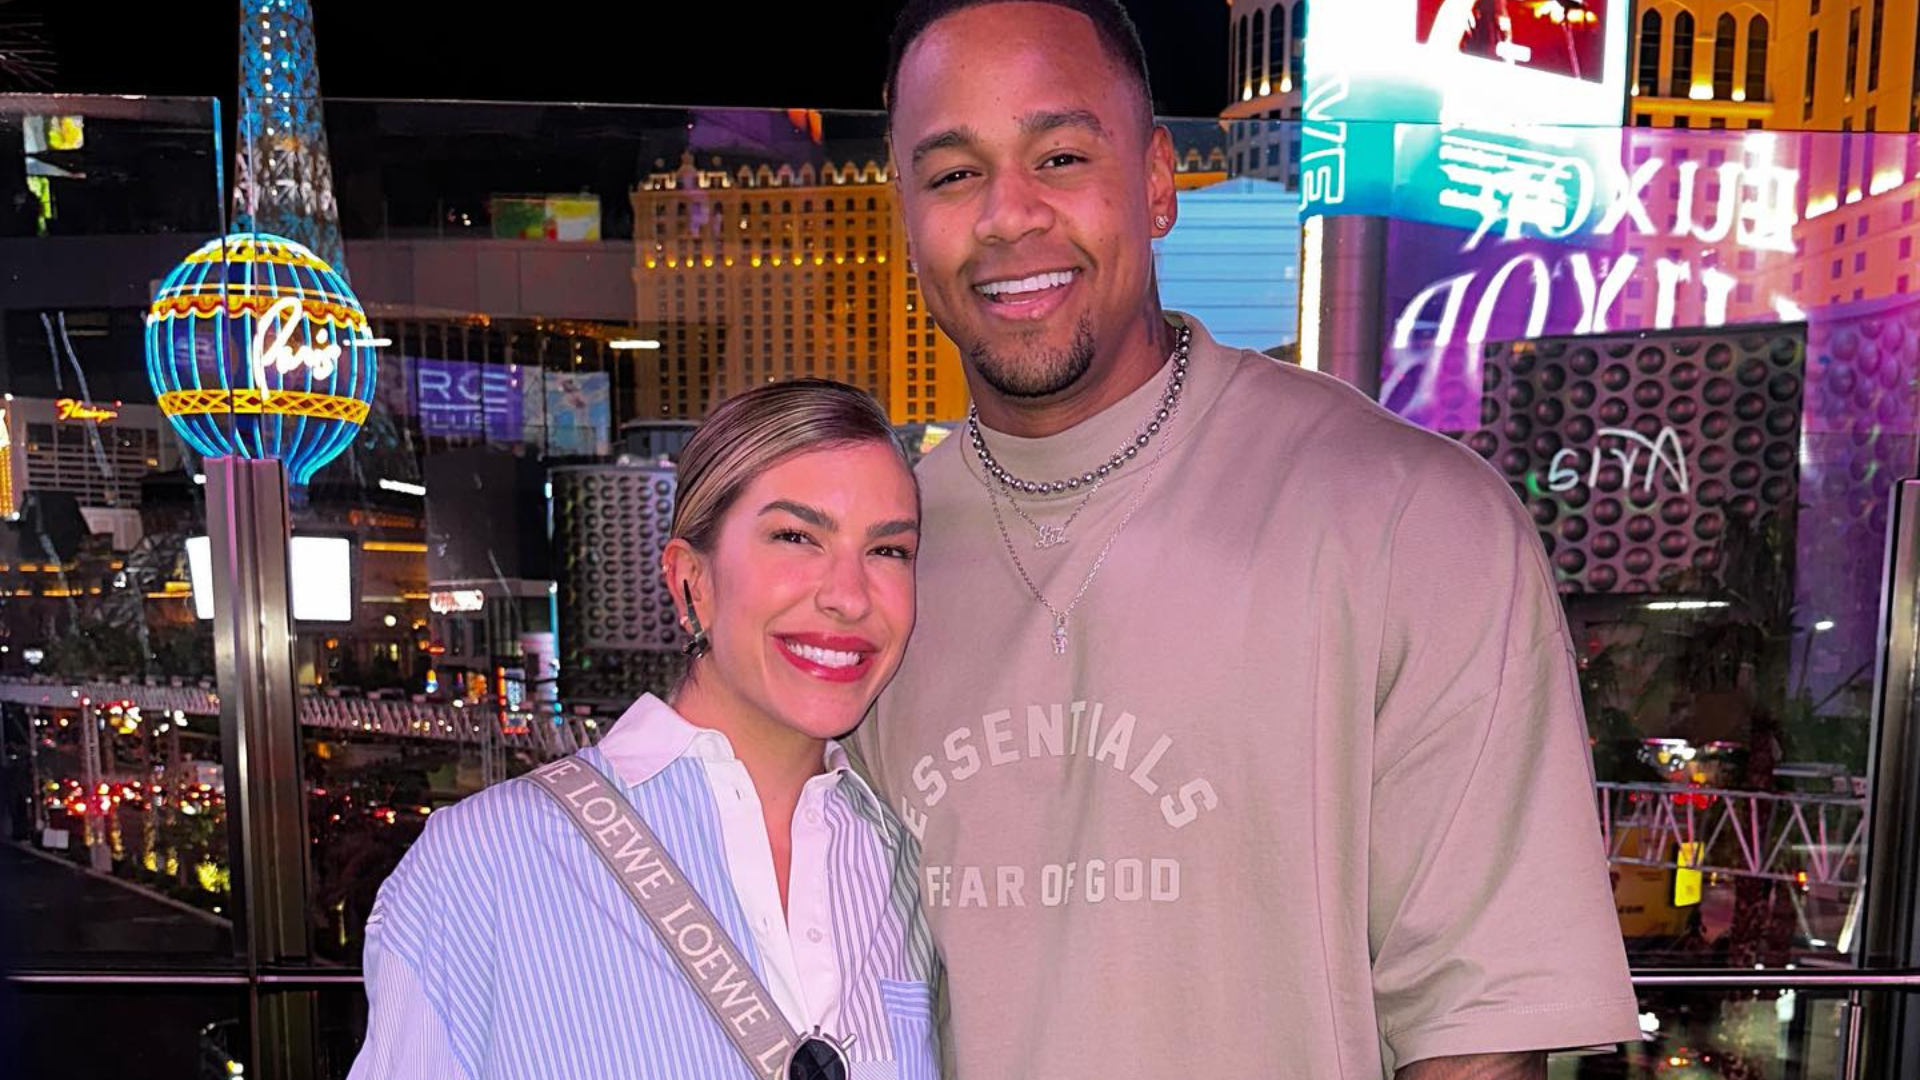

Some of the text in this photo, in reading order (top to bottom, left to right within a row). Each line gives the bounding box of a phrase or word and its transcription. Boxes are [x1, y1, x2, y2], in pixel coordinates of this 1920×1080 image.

[253, 297, 342, 400] Paris
[902, 701, 1218, 841] ESSENTIALS
[565, 780, 675, 899] LOEWE
[661, 899, 771, 1037] LOEWE
[756, 1036, 790, 1080] L
[926, 858, 1180, 907] FEAR OF GOD
